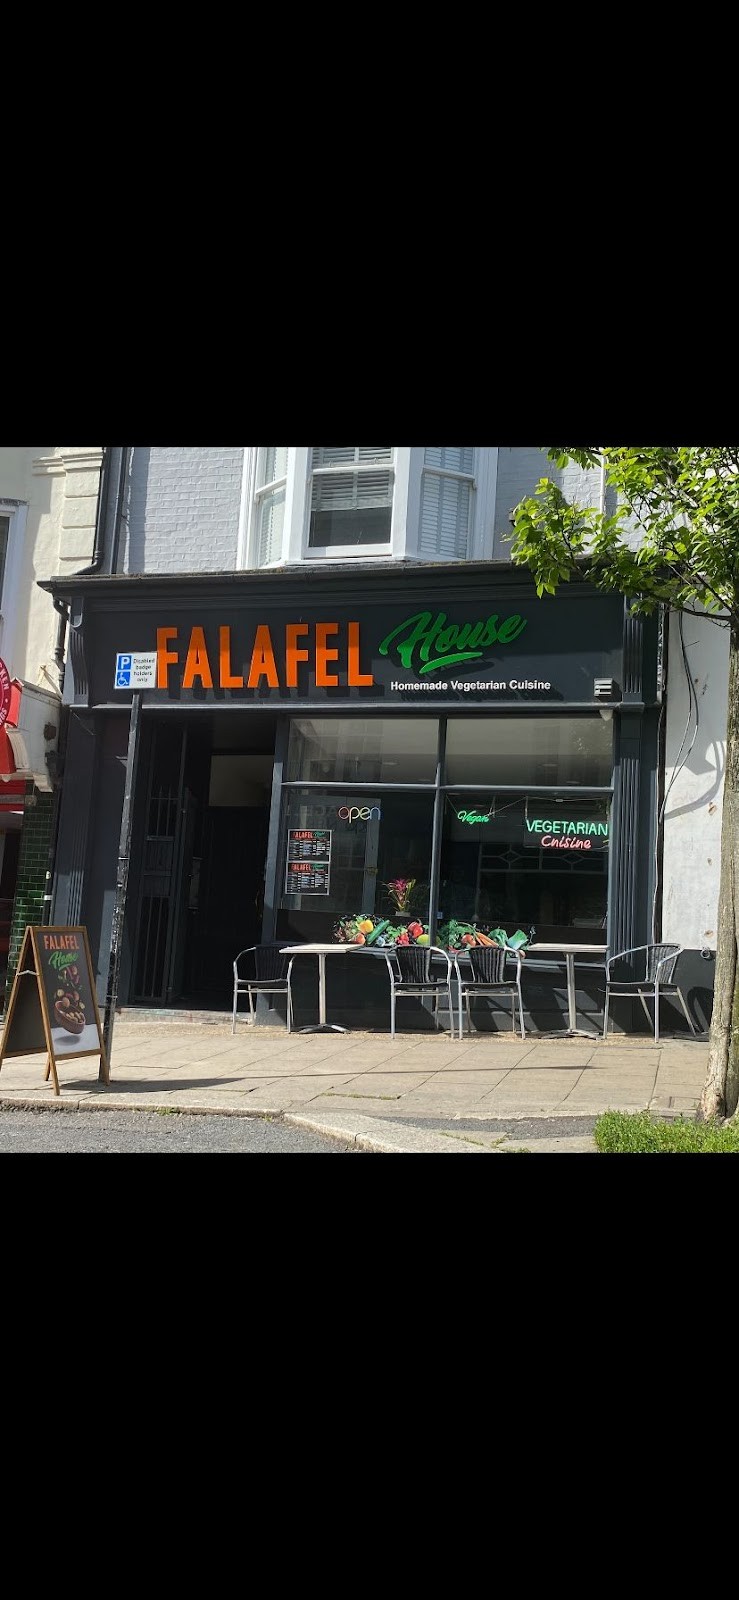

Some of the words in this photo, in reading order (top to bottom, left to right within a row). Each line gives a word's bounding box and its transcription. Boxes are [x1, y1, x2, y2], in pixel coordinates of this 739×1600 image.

[379, 612, 528, 669] House
[157, 622, 373, 688] FALAFEL
[121, 656, 131, 670] P
[390, 681, 448, 691] Homemade
[451, 681, 506, 692] Vegetarian
[509, 680, 551, 690] Cuisine
[338, 806, 381, 823] open
[457, 810, 489, 824] Vegan
[526, 820, 608, 836] VEGETARIAN
[44, 935, 80, 950] FALAFEL
